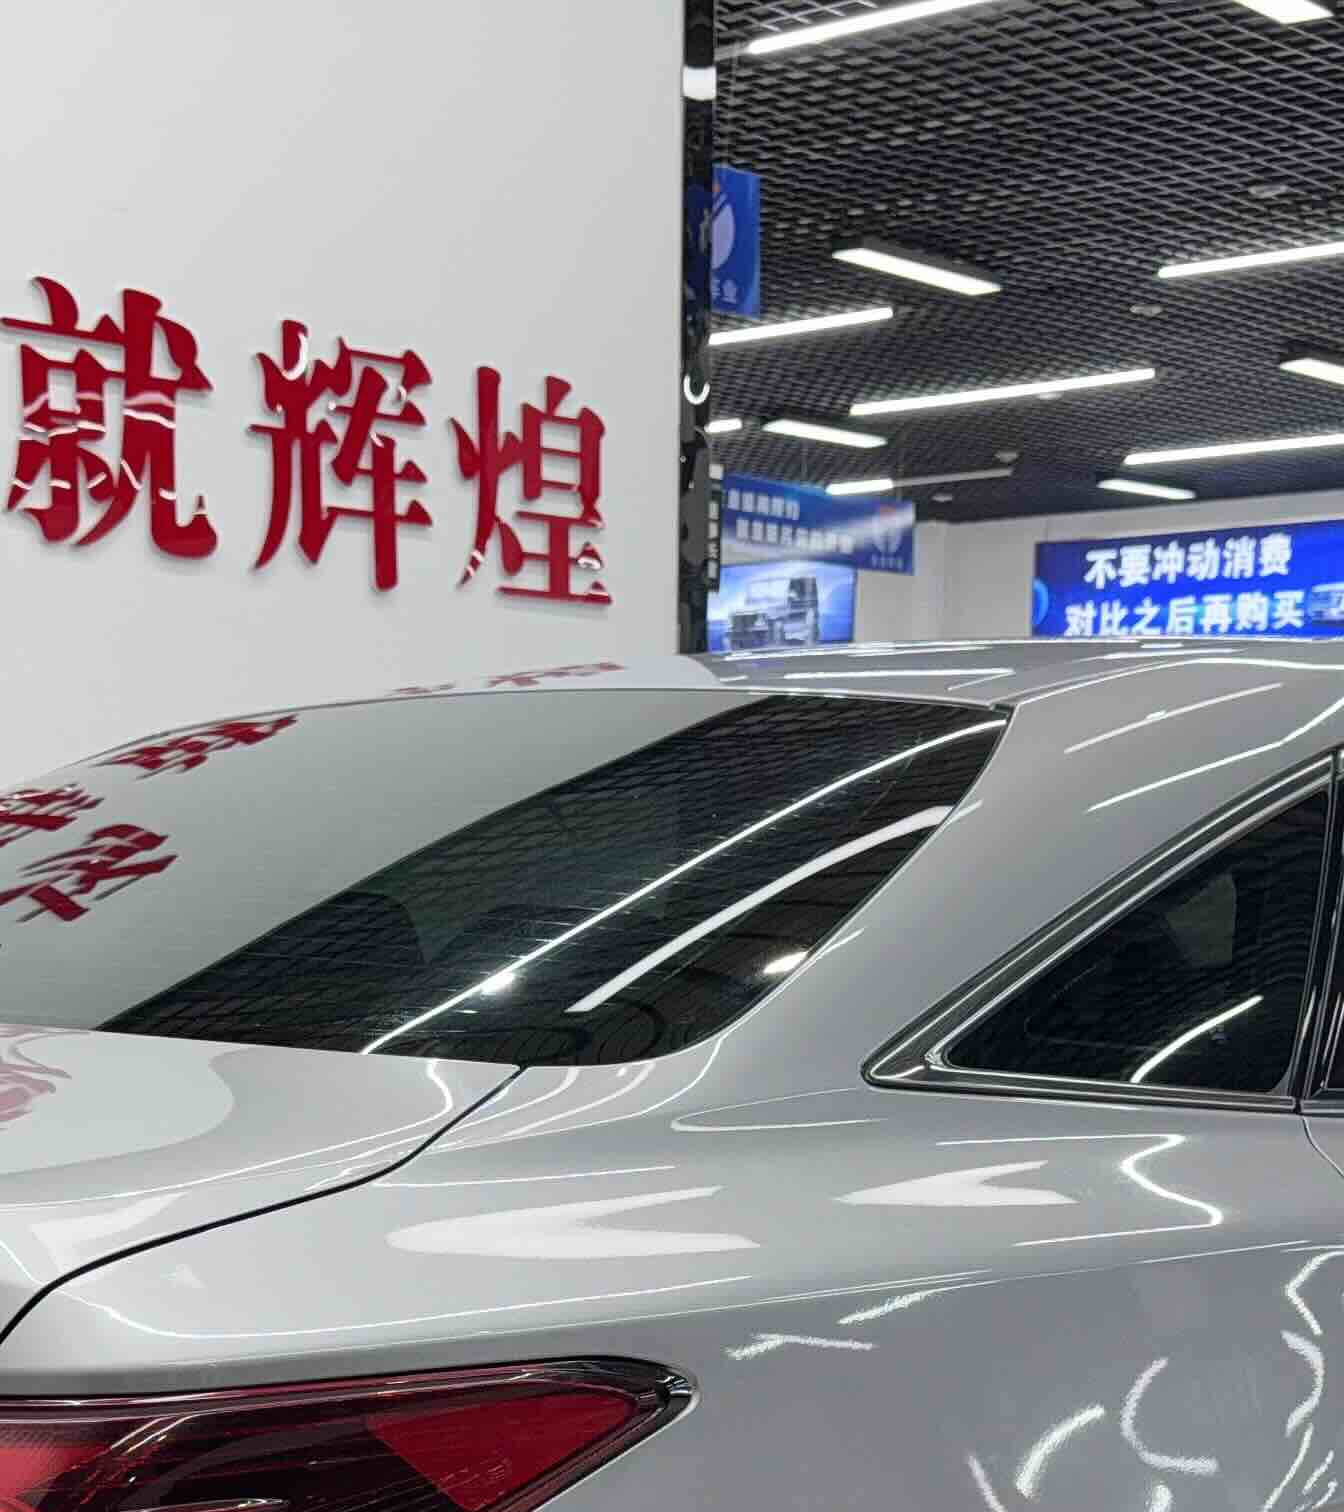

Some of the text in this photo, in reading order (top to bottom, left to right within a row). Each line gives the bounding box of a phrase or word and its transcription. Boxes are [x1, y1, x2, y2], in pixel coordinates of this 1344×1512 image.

[1084, 532, 1293, 589] 不要冲动消费
[1062, 589, 1306, 638] 对比之后再购买
